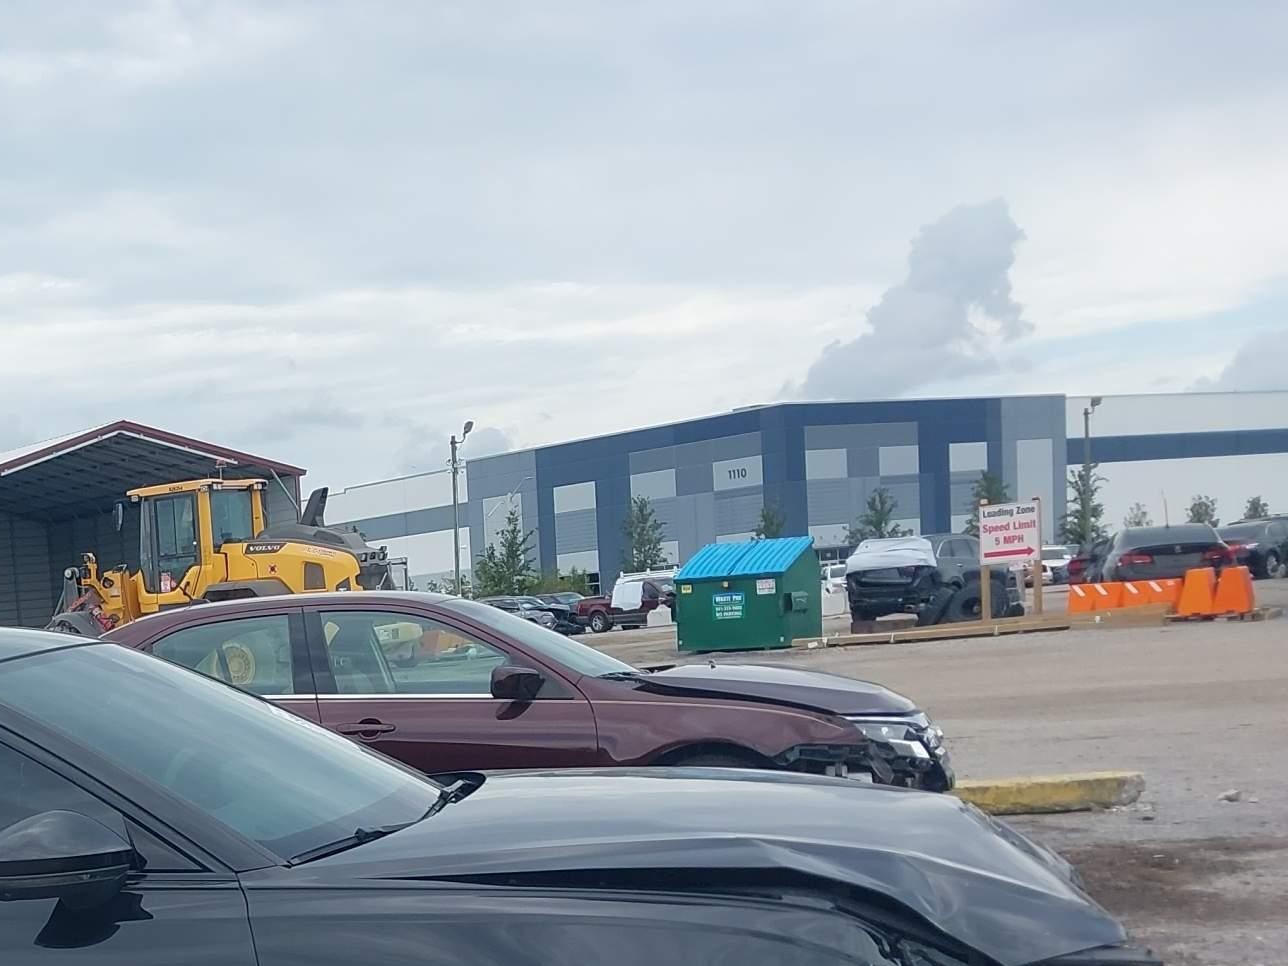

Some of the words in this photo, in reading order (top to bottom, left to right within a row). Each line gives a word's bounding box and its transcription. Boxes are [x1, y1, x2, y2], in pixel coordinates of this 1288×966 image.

[728, 467, 747, 480] 1110
[983, 508, 1014, 518] Loading
[1016, 506, 1035, 514] Zone
[983, 522, 1010, 534] Speed
[1013, 520, 1036, 530] Limit
[994, 537, 1000, 545] 5
[1003, 534, 1024, 545] MPH
